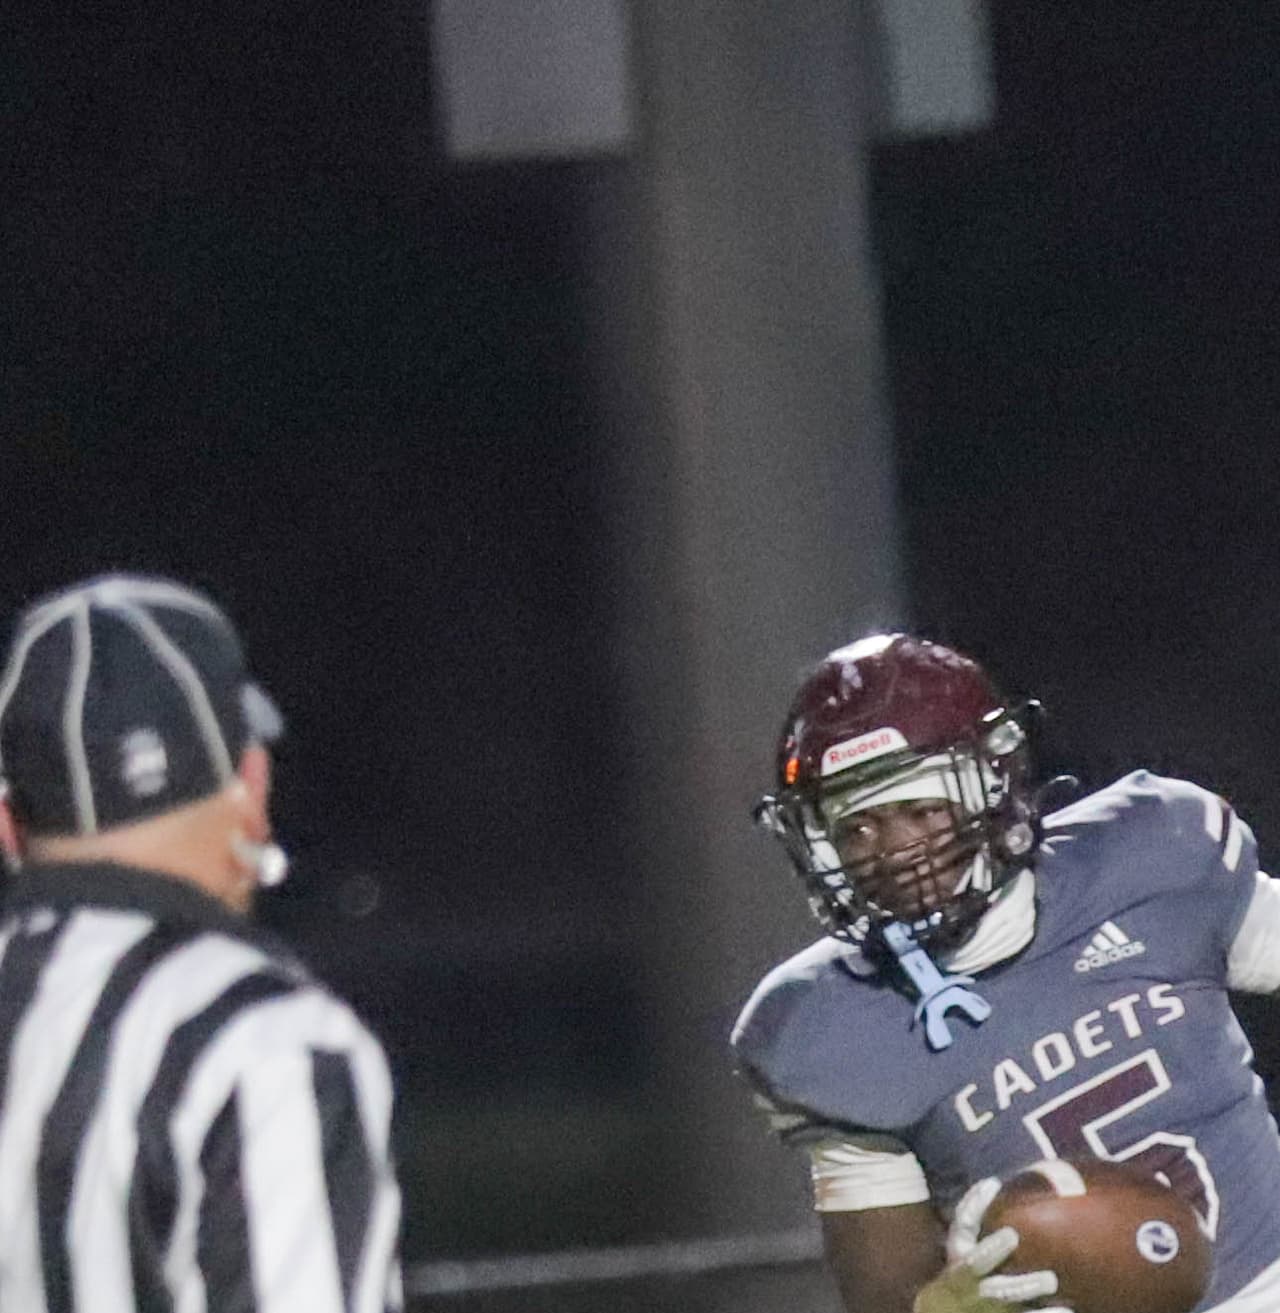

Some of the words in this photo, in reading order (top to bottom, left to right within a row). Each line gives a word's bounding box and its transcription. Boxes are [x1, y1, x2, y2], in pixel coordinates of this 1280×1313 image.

[1074, 941, 1146, 972] adidas
[954, 983, 1187, 1132] CADETS
[1023, 1049, 1220, 1242] 5
